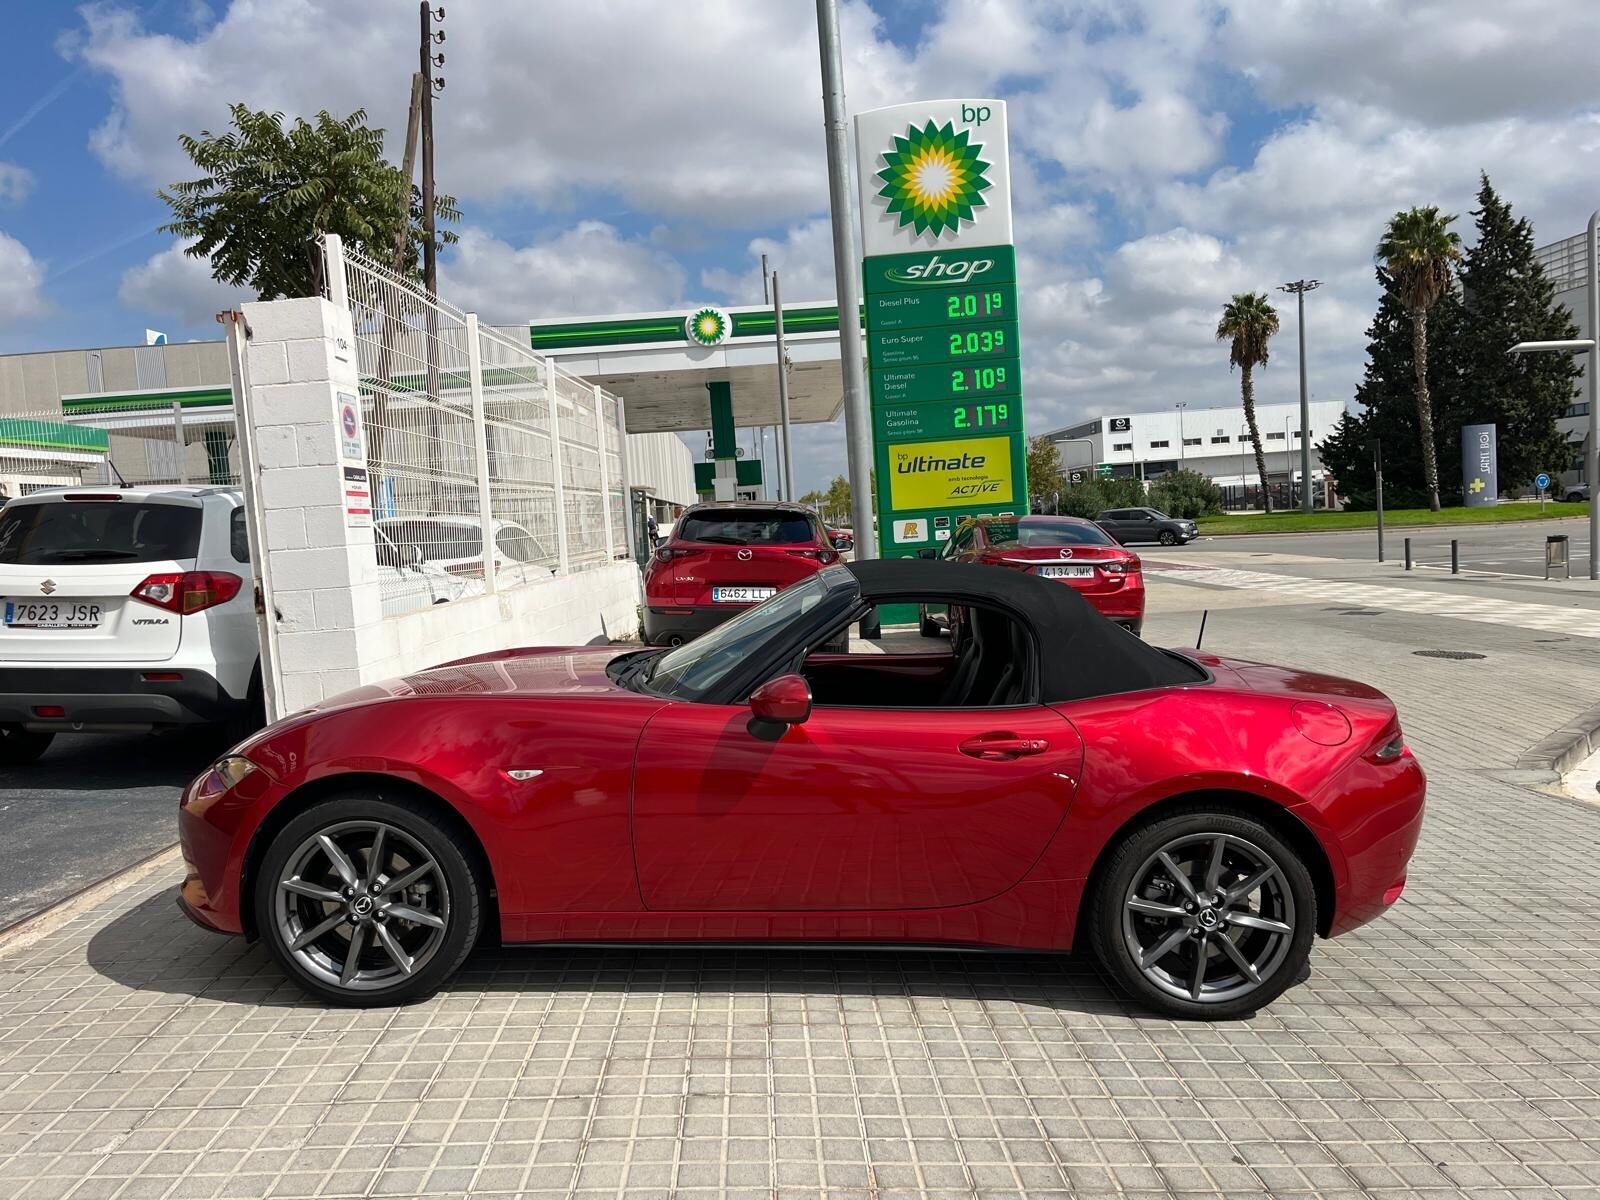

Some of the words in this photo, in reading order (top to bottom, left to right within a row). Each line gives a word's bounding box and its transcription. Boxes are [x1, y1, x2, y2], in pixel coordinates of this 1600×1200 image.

[961, 103, 991, 127] bp
[905, 255, 995, 282] shop
[879, 299, 902, 308] Diesel
[903, 297, 920, 305] Plus
[947, 292, 1002, 318] 2.019
[881, 337, 900, 345] Euro
[901, 335, 923, 344] Super
[949, 330, 1004, 355] 2.039
[883, 372, 916, 382] Ultimate
[951, 367, 1006, 392] 2.109
[884, 382, 907, 391] Diesel
[885, 409, 918, 418] Ultimate
[953, 404, 1008, 429] 2.179
[886, 418, 919, 427] Gasolina
[897, 452, 909, 461] bp
[897, 452, 986, 474] ultimate
[951, 482, 1000, 495] ACTIVE
[1043, 567, 1070, 577] 4134
[1073, 566, 1092, 577] JMK
[719, 588, 748, 599] 6462
[16, 604, 59, 622] 7623
[66, 604, 101, 622] JSR
[131, 618, 170, 626] VITARA
